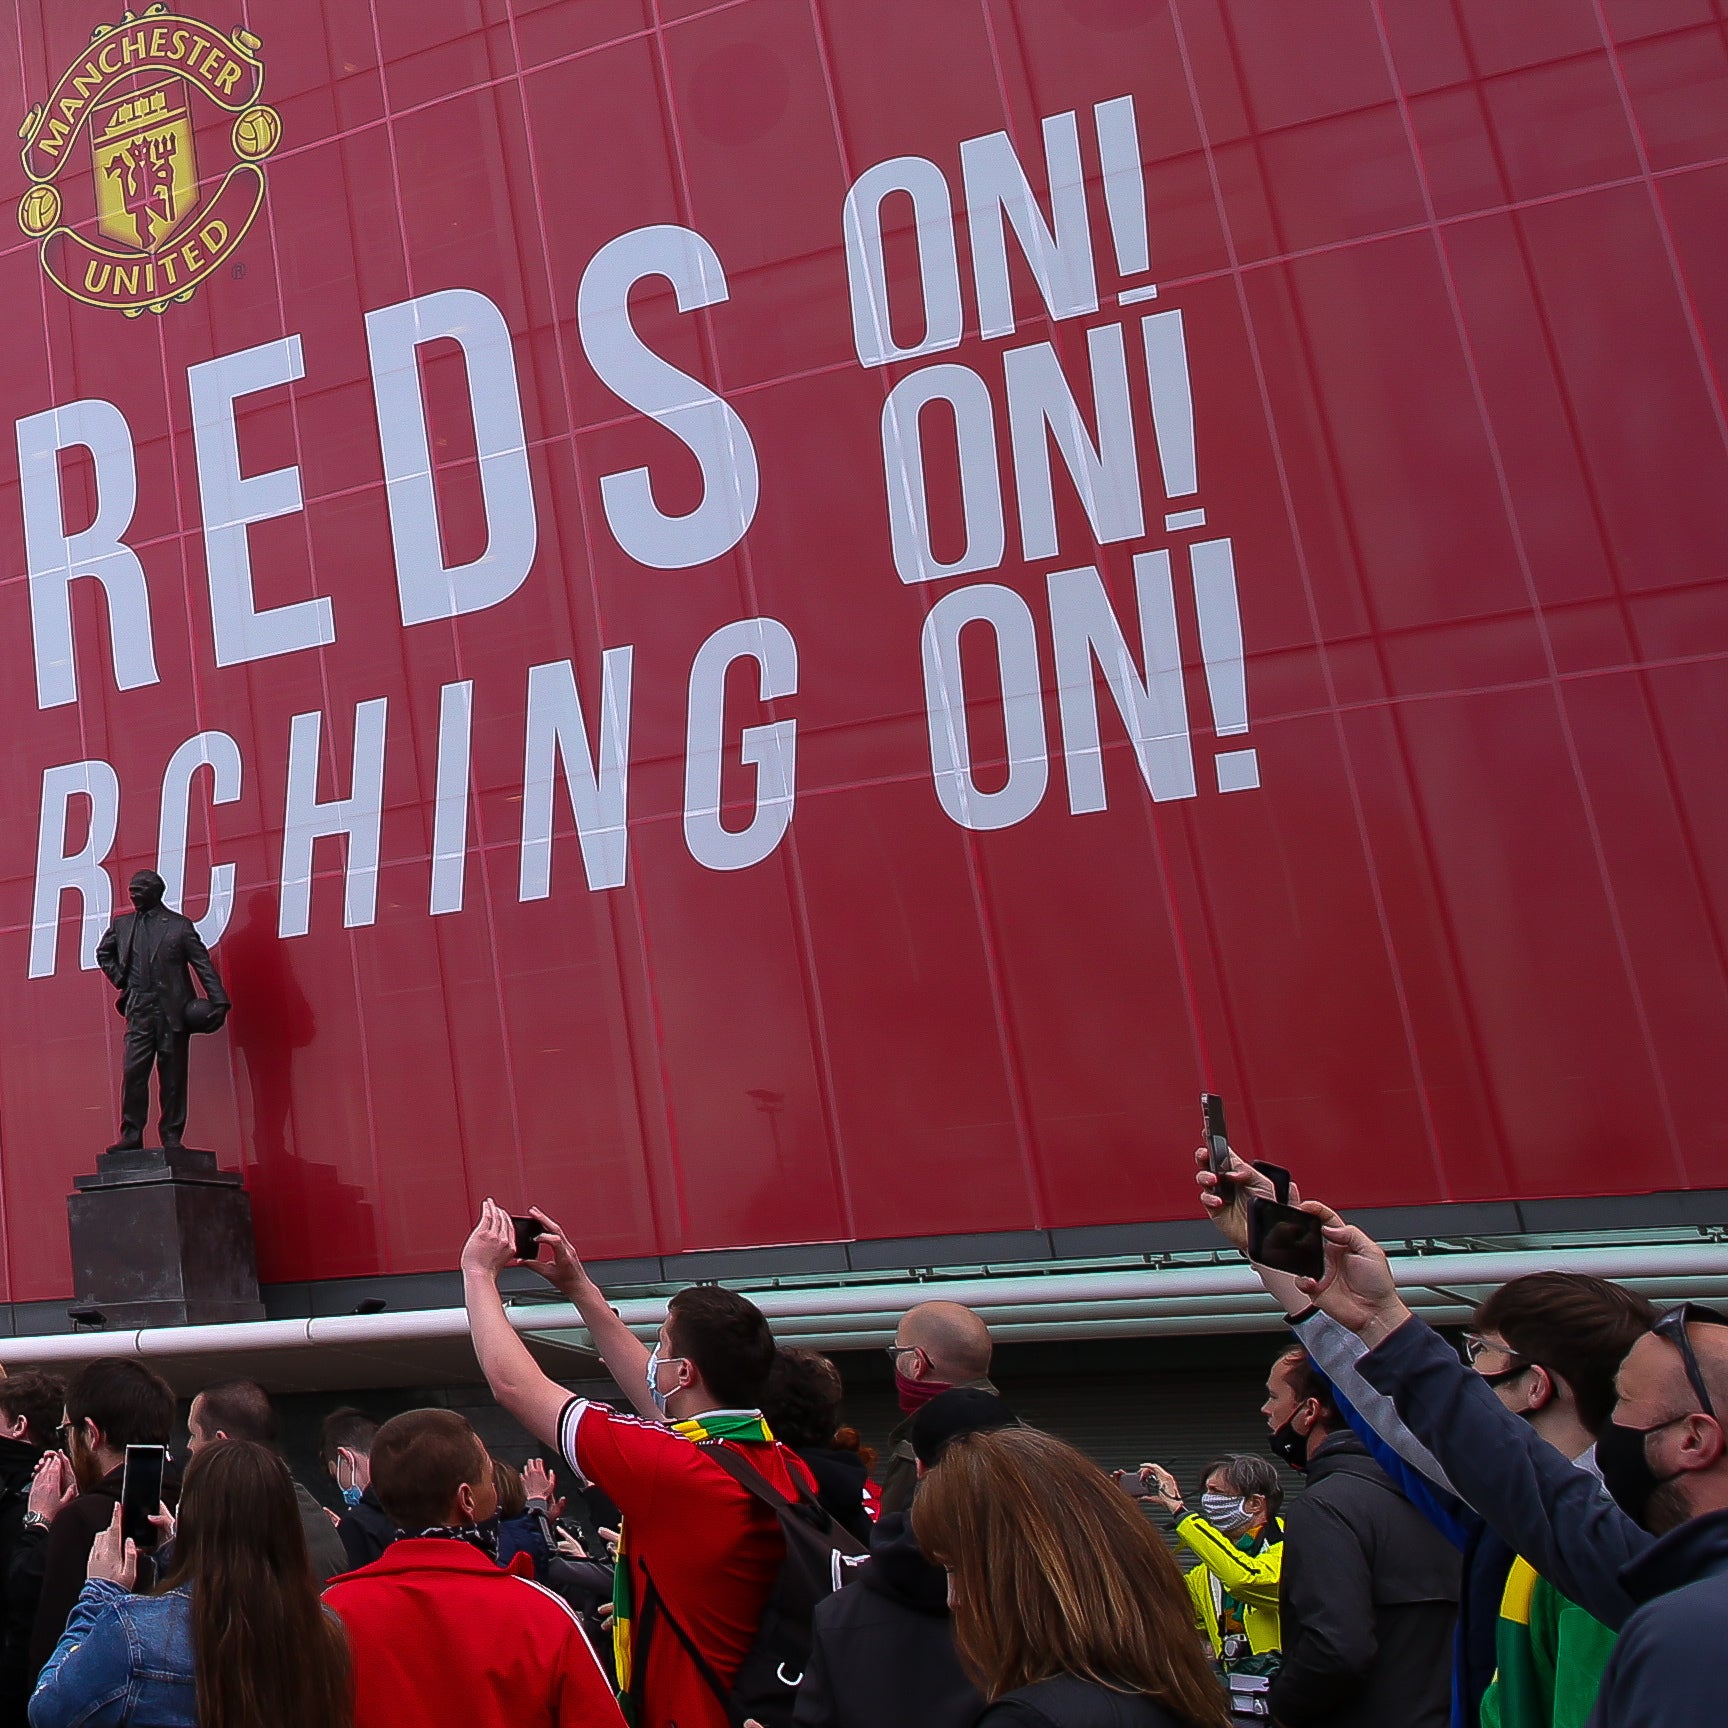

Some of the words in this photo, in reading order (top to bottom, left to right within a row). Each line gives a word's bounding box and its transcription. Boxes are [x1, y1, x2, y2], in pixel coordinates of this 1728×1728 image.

[38, 27, 243, 157] MANCHESTER
[83, 220, 230, 295] UNITED
[15, 224, 760, 710] REDS
[842, 95, 1157, 369] ON!
[881, 308, 1208, 585] ON!
[921, 537, 1261, 831] ON!
